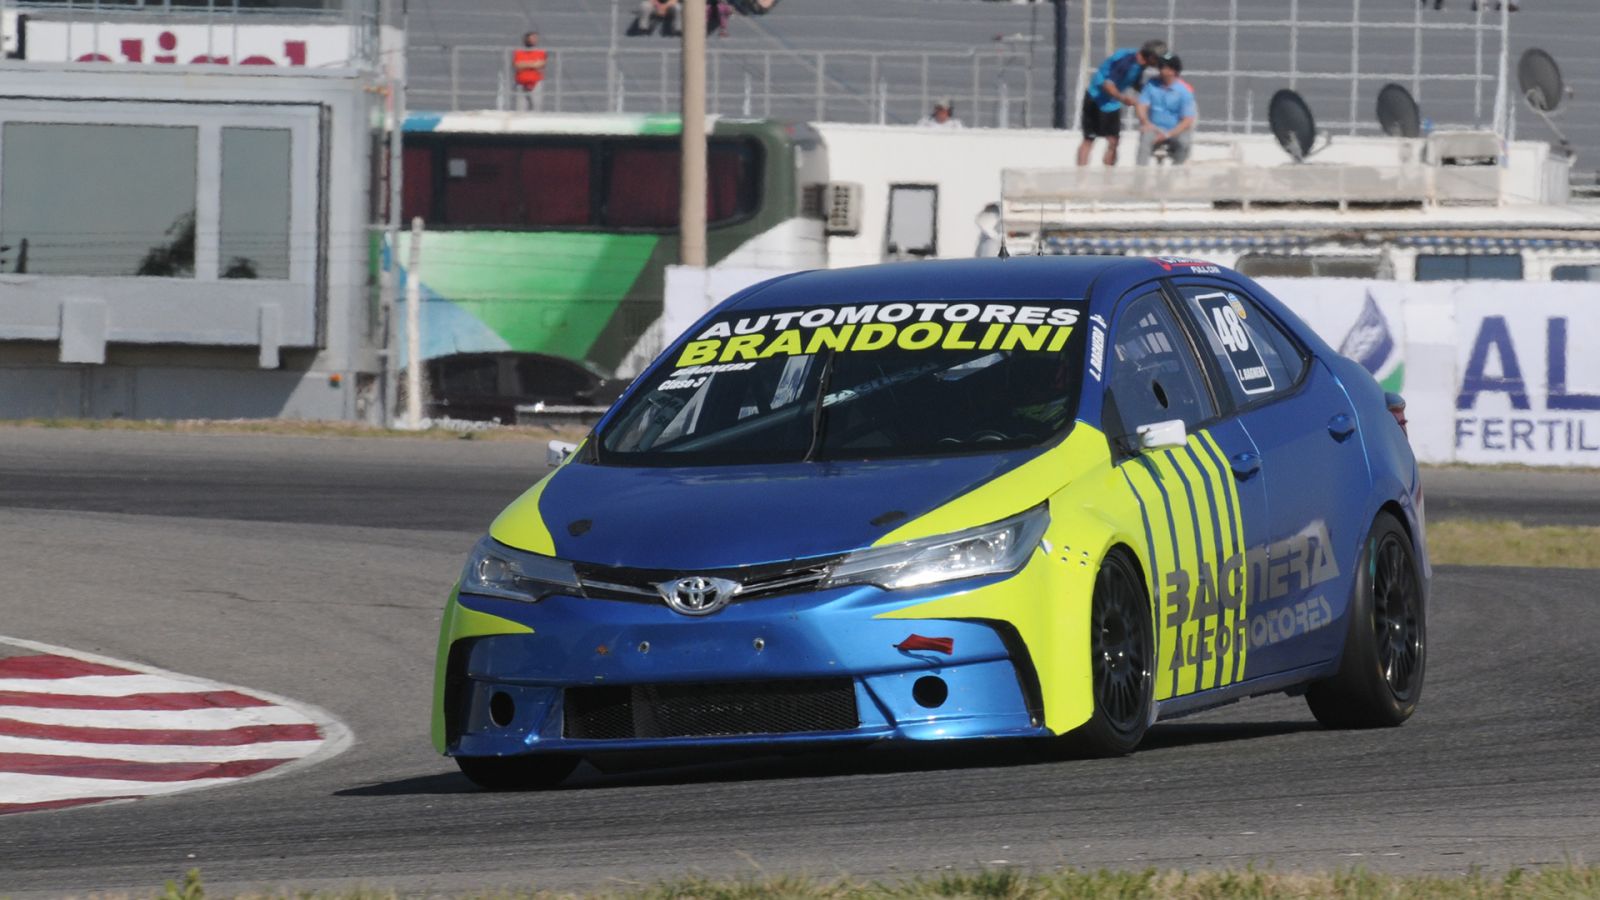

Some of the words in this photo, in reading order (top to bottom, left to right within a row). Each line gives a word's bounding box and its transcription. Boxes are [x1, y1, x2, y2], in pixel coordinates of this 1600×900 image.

[674, 322, 1073, 367] BRANDOLINI
[696, 303, 1080, 341] AUTOMOTORES
[1212, 305, 1249, 352] 48
[1455, 314, 1600, 410] AL
[1455, 417, 1600, 452] FERTIL
[1165, 519, 1340, 629] BAGNERA
[1168, 595, 1332, 671] AUTOMOTORES
